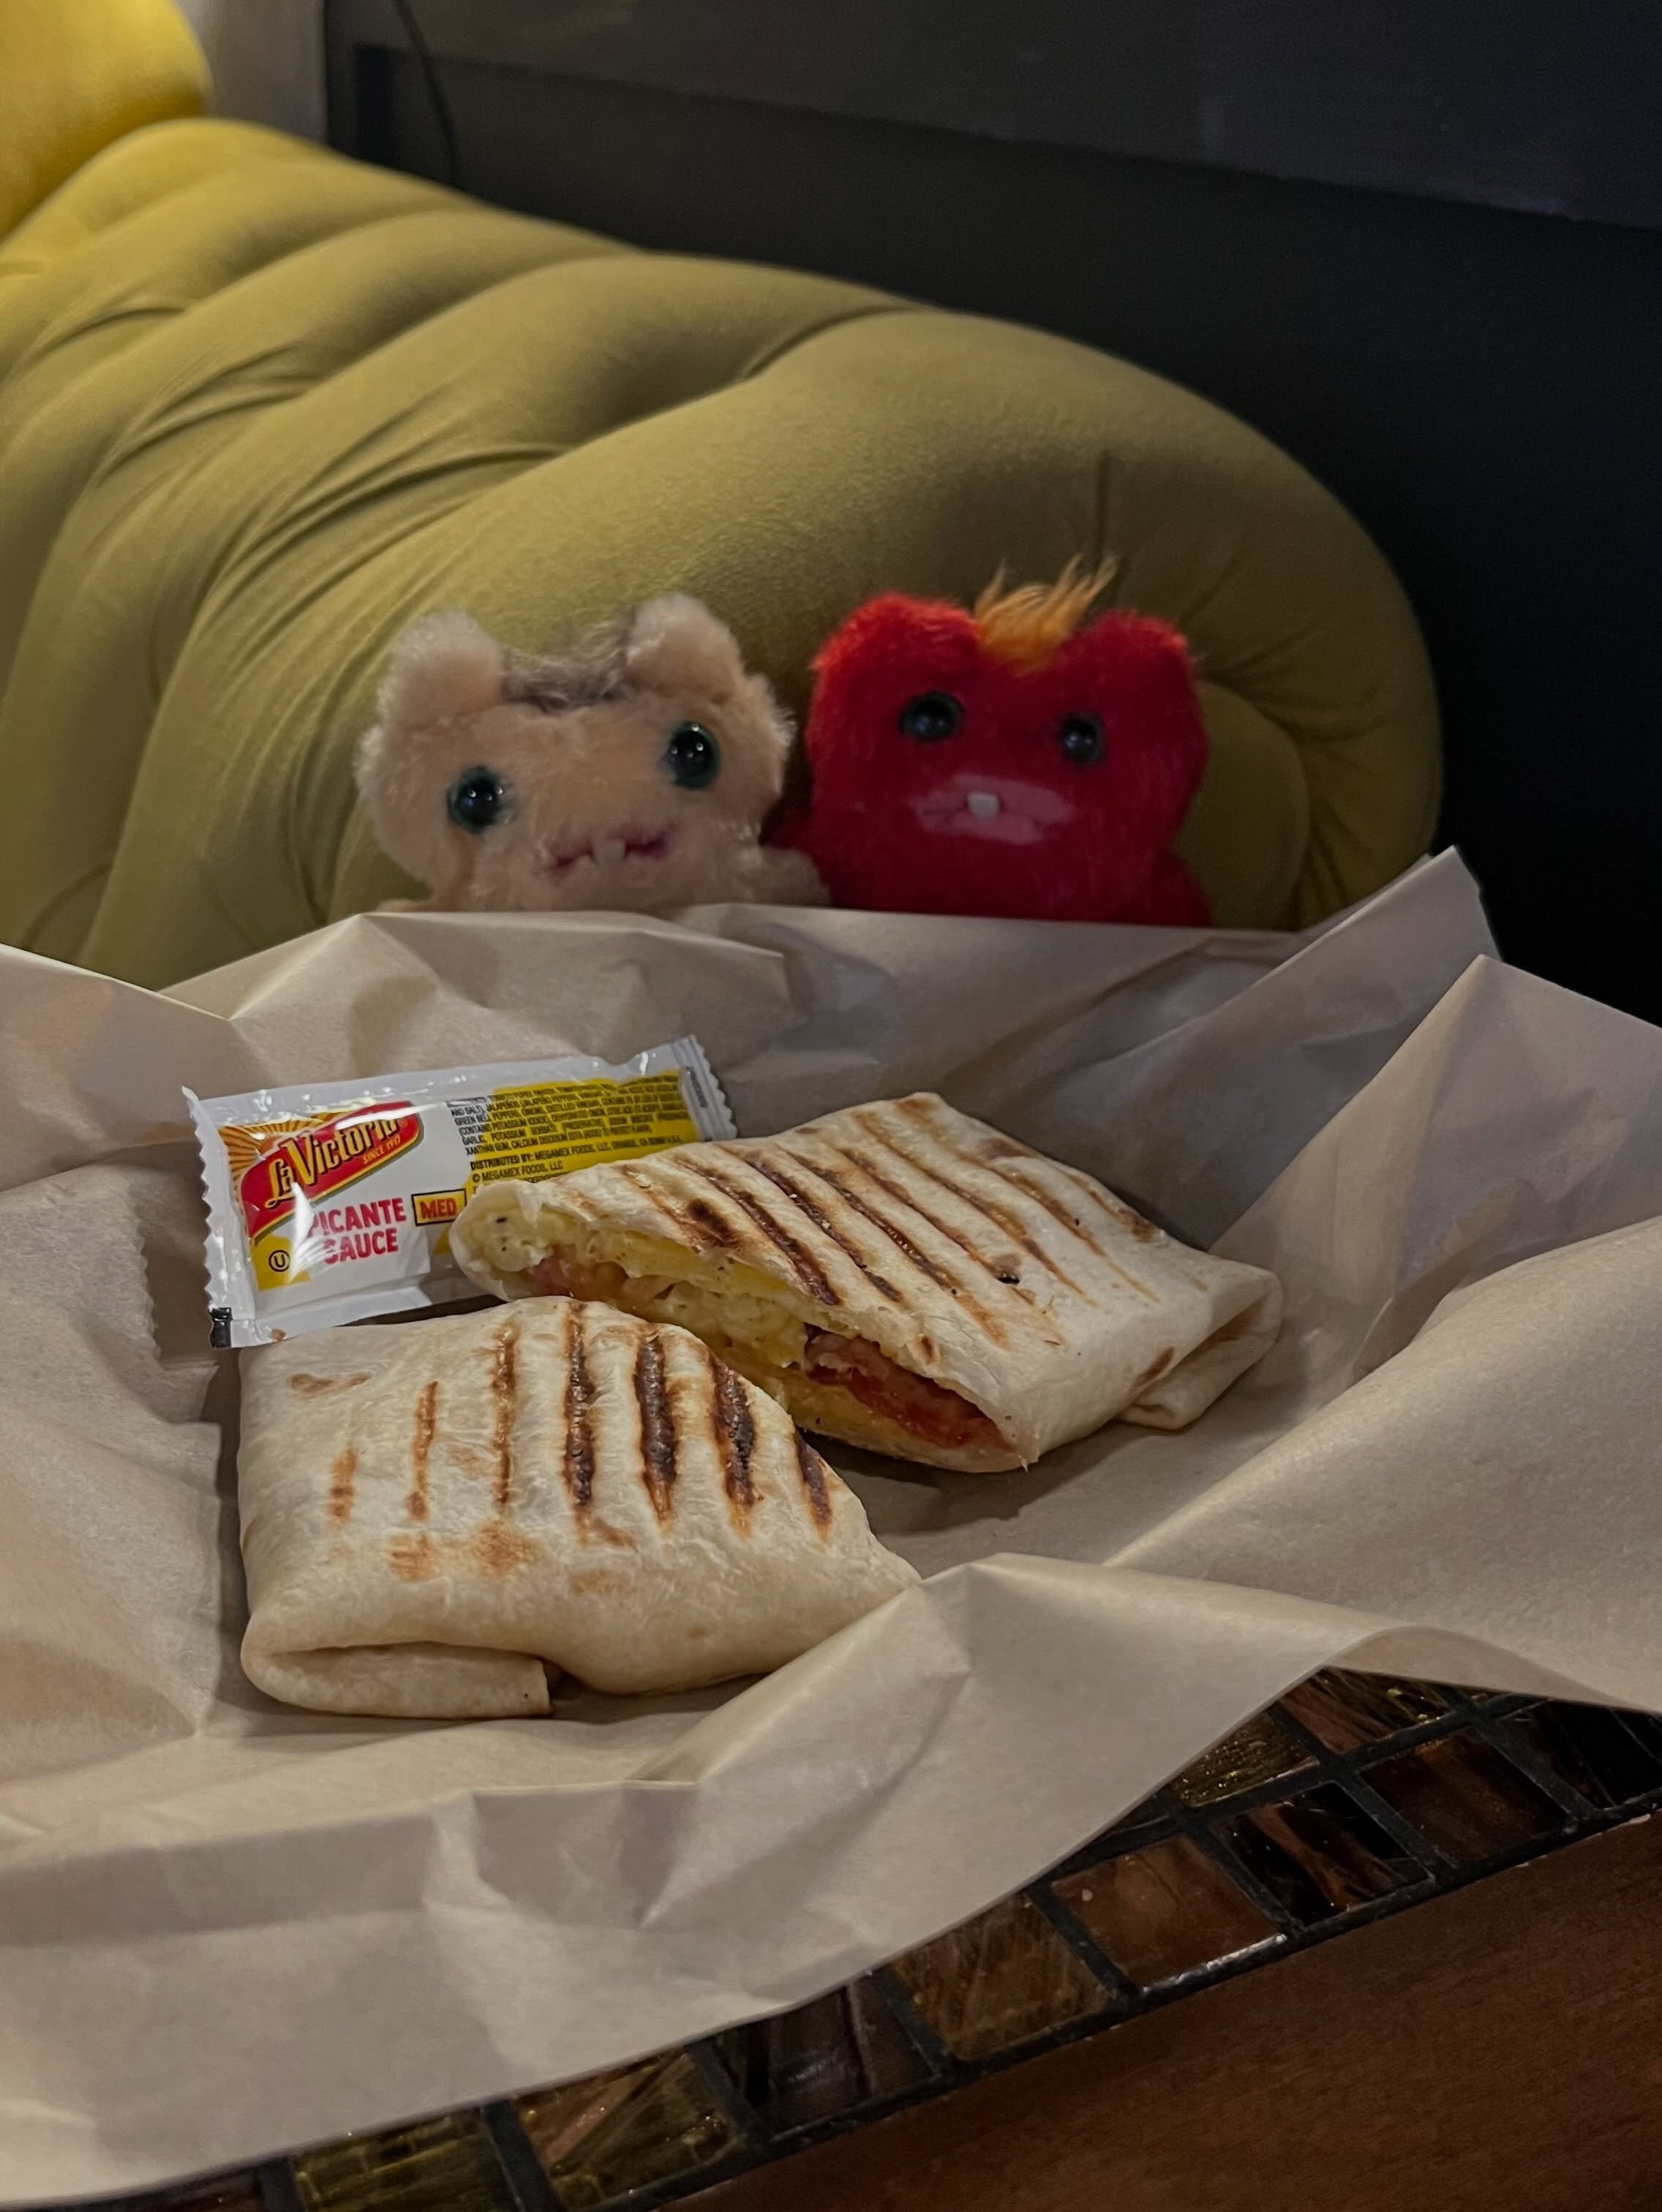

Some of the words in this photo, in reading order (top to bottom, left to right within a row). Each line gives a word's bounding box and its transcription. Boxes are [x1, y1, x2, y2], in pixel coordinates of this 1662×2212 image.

[470, 1155, 520, 1170] DISTRIBUTED
[534, 1148, 570, 1161] MEGAMEX
[481, 1167, 521, 1181] MEGAMEX
[549, 1159, 564, 1170] LLC
[419, 1197, 457, 1220] MED
[323, 1227, 399, 1265] SAUCE
